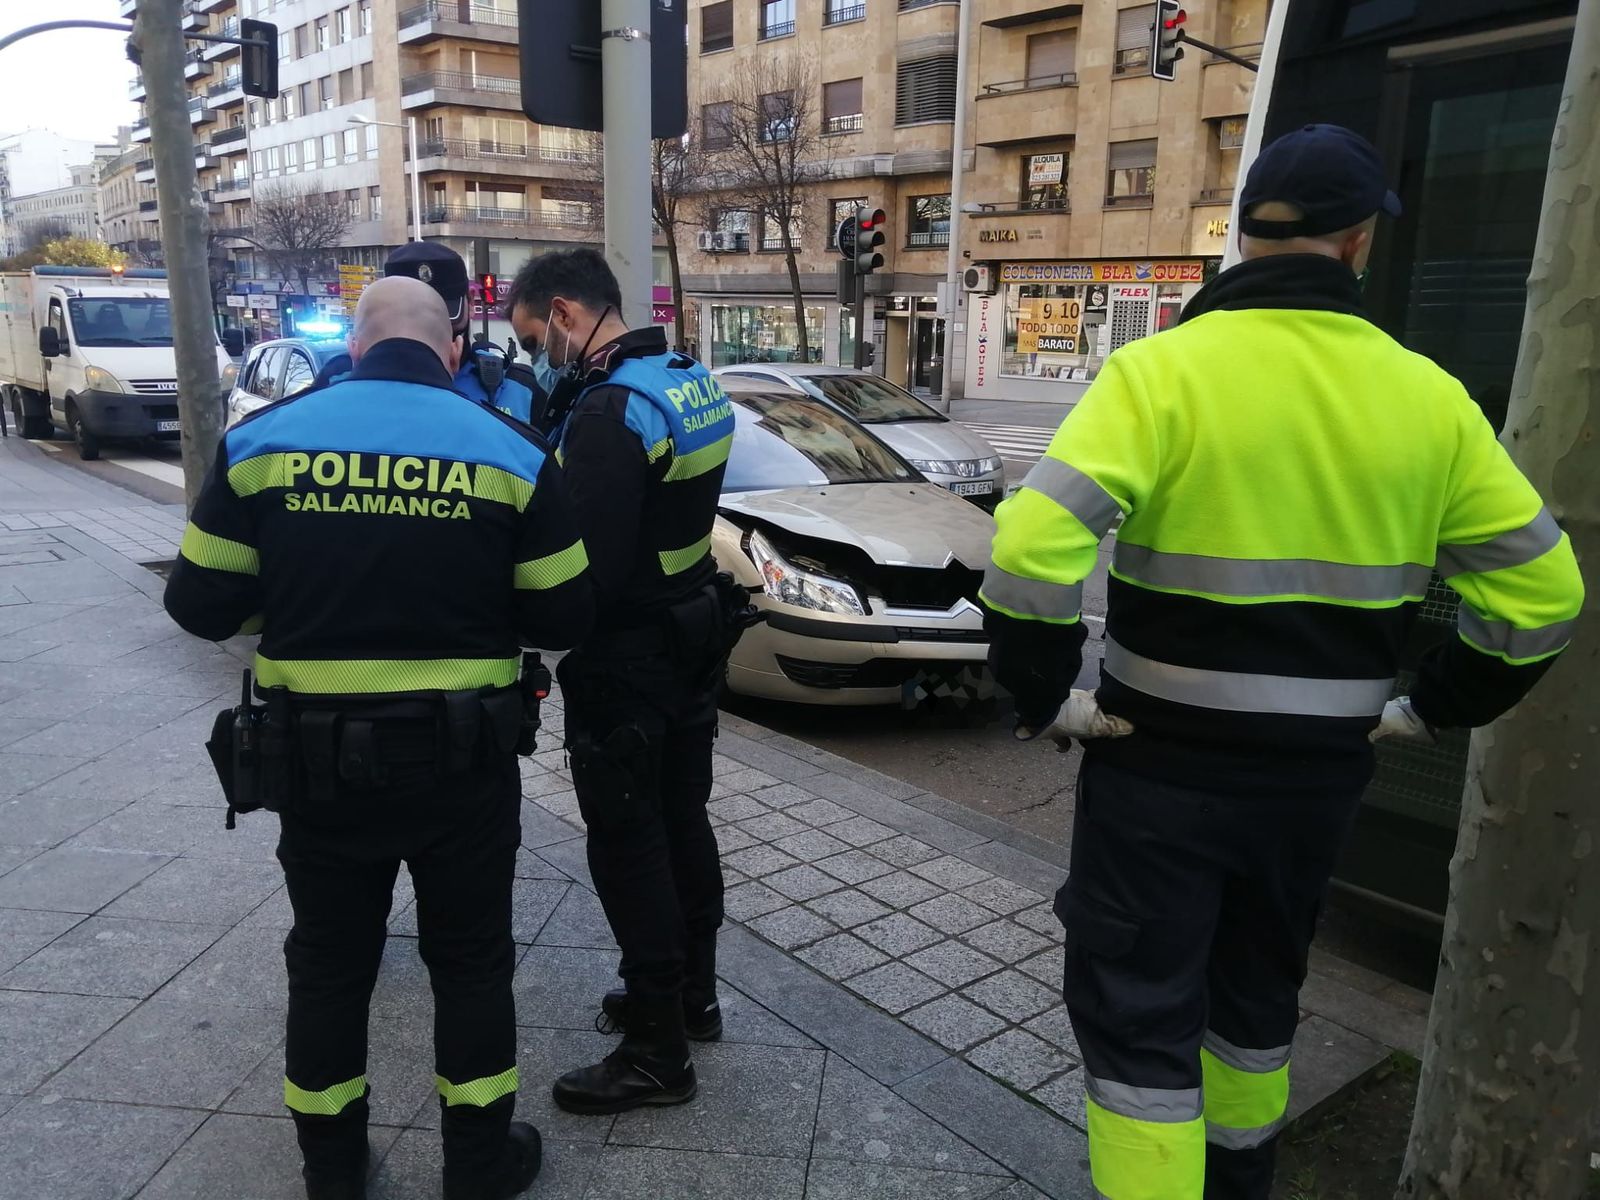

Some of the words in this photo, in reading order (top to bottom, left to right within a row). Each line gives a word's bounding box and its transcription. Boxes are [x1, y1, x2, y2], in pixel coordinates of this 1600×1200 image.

[1033, 155, 1061, 164] ALQUILA
[979, 229, 1019, 243] MAIKA
[1003, 264, 1094, 280] COLCHONERIA
[1120, 288, 1150, 297] FLEX
[1060, 302, 1080, 319] 10
[1020, 322, 1048, 334] TODO
[1050, 323, 1079, 335] TODO
[1038, 338, 1075, 350] BARATO
[284, 451, 473, 496] POLICIA
[956, 483, 976, 496] 1943
[284, 491, 472, 520] SALAMANCA
